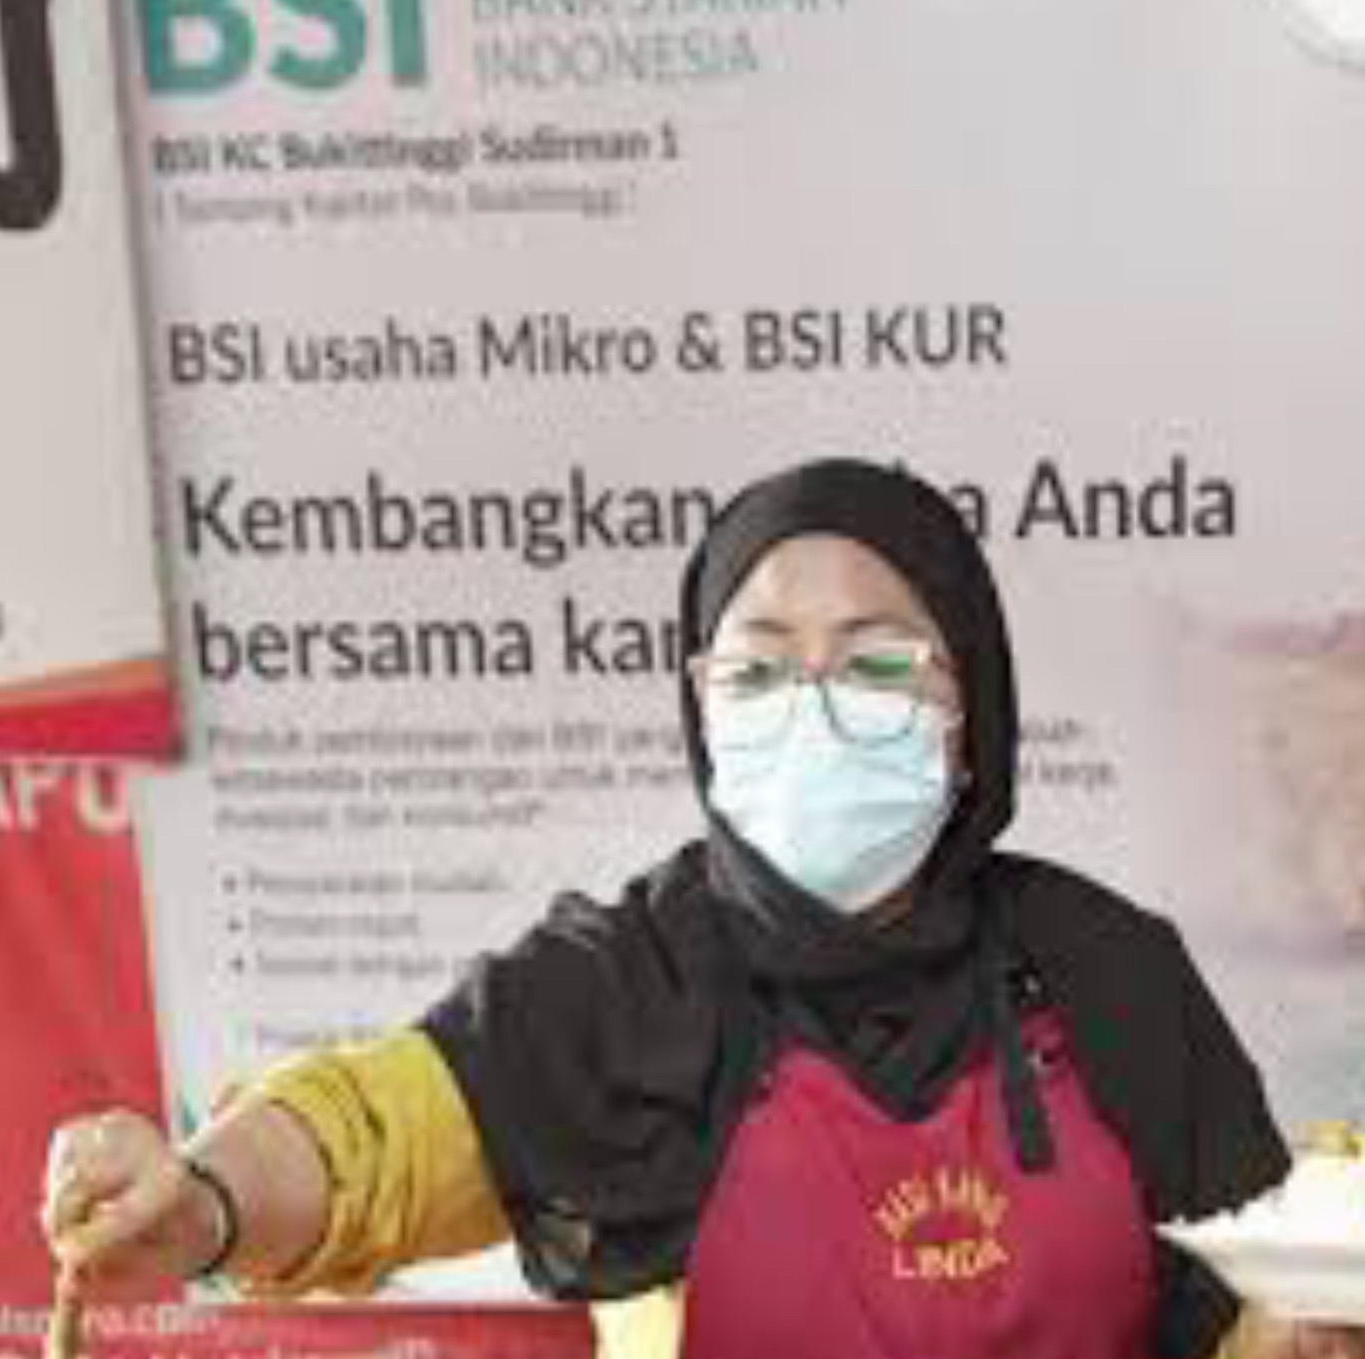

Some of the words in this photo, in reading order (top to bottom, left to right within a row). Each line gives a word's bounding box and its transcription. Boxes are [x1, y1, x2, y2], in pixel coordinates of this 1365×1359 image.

[473, 24, 759, 90] INDONESIA
[168, 323, 264, 384] BSI
[285, 319, 458, 383] usaha
[478, 313, 657, 378] Mikro
[676, 311, 724, 372] &
[744, 309, 843, 371] BSI
[866, 304, 1007, 369] KUR
[181, 466, 713, 566] Kembangkan
[1013, 455, 1236, 540] Anda
[194, 599, 534, 683] bersama
[891, 1238, 1011, 1280] LINDA
